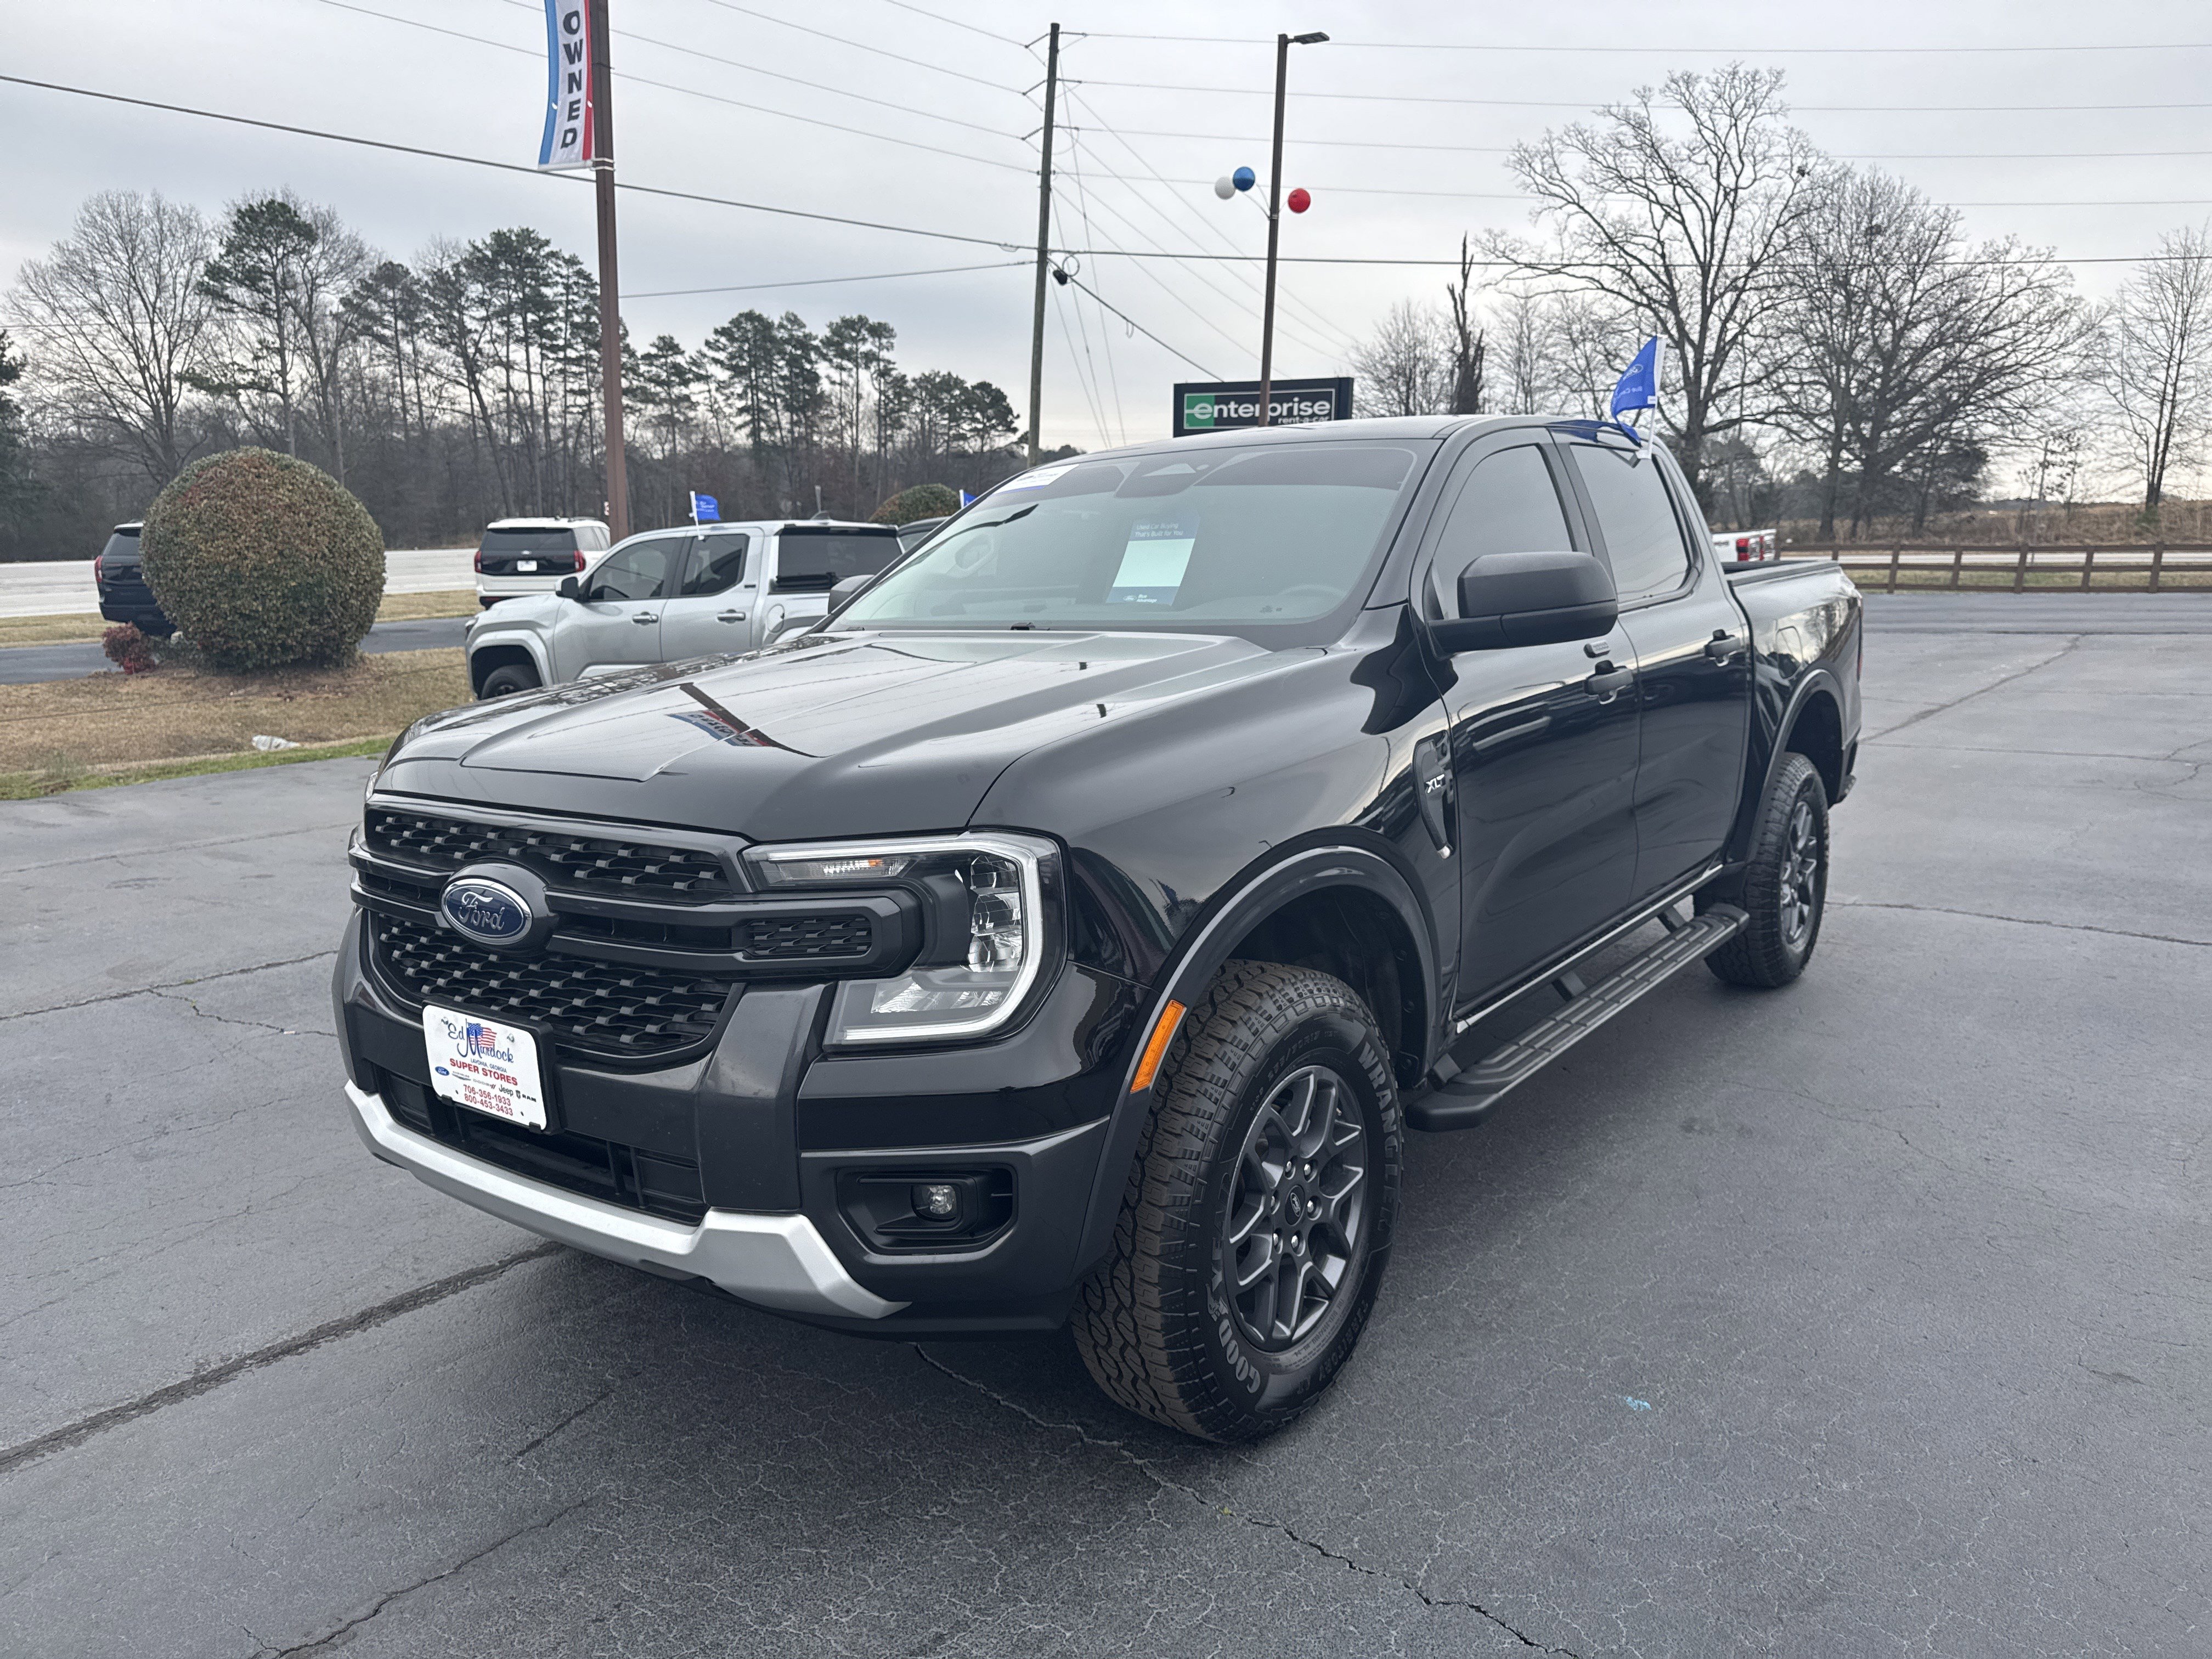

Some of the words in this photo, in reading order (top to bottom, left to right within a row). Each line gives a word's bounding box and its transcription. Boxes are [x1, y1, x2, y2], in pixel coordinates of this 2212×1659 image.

[561, 10, 583, 149] OWNED
[1193, 398, 1330, 421] enterprise
[1278, 416, 1330, 425] rent-a-car
[1425, 774, 1446, 793] XLT
[458, 891, 505, 930] Ford
[447, 1022, 466, 1041] Ed
[457, 1026, 514, 1063] Murdock
[449, 1058, 479, 1074] SUPER
[482, 1068, 517, 1086] STORES
[464, 1084, 511, 1105] 706-356-1933
[498, 1084, 514, 1097] Jeep
[465, 1093, 513, 1115] 800-453-3433
[1358, 1041, 1398, 1233] WRANGLER
[1210, 1172, 1261, 1394] GOODYEAR
